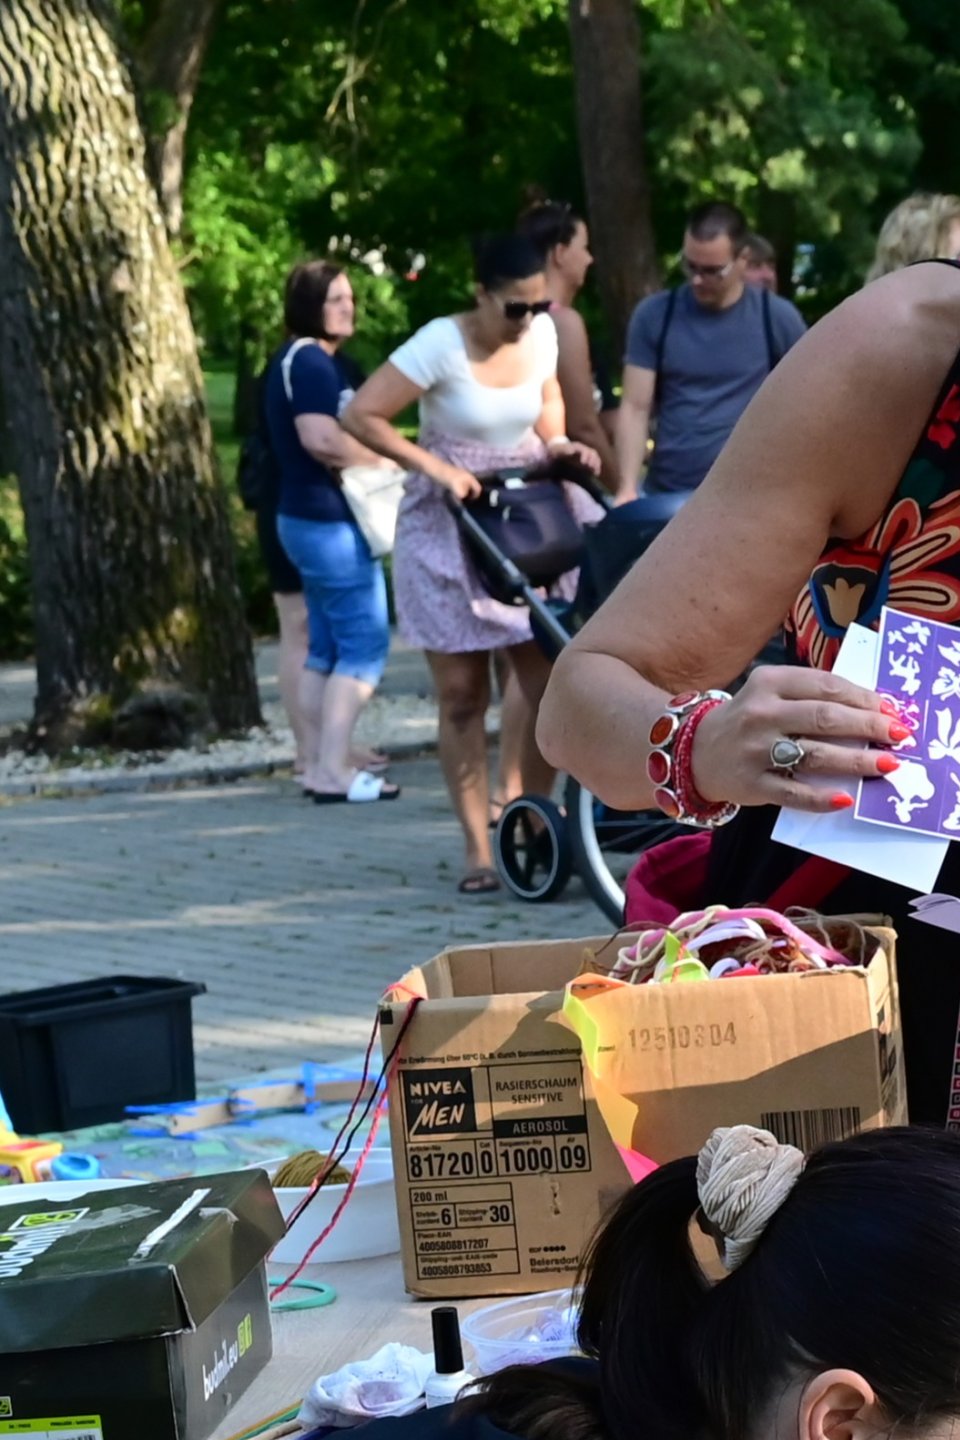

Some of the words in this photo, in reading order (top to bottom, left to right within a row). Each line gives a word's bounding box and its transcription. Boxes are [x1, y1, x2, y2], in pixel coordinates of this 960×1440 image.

[410, 1080, 466, 1097] NIVEA
[495, 1078, 577, 1091] RASIERSCHAUM
[511, 1092, 563, 1104] SENSITIVE
[411, 1101, 465, 1132] MEN
[512, 1120, 569, 1134] AEROSOL
[410, 1152, 474, 1178] 81720
[480, 1150, 493, 1174] 0
[500, 1147, 553, 1173] 1000
[560, 1145, 586, 1169] 09
[413, 1192, 432, 1202] 200
[434, 1190, 448, 1201] ml
[441, 1208, 452, 1225] 6
[489, 1205, 510, 1222] 30
[529, 1255, 579, 1267] Beiersdorf
